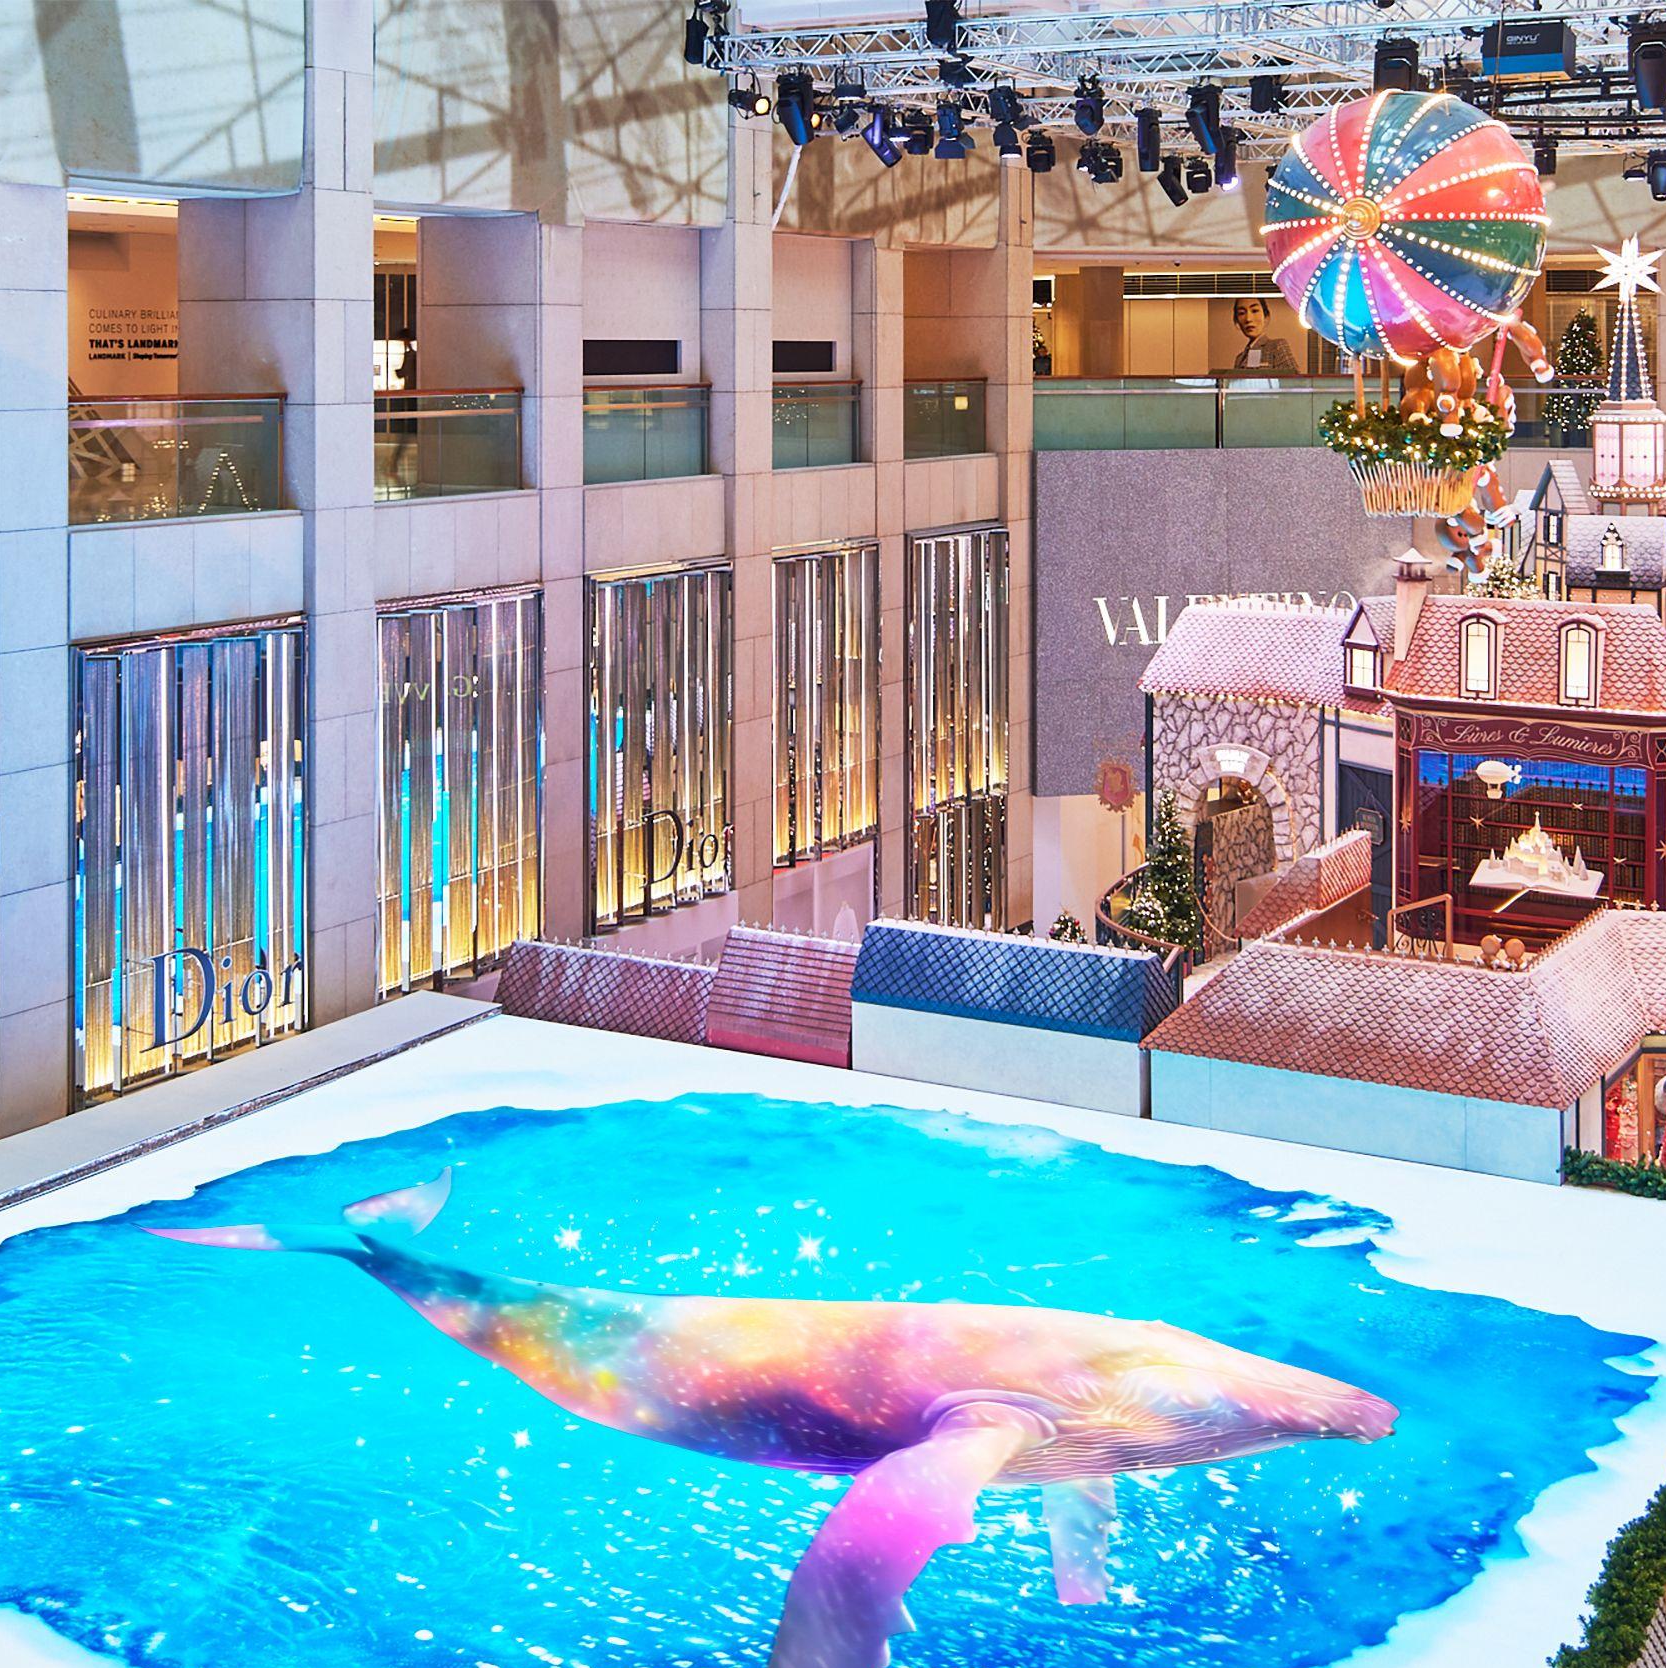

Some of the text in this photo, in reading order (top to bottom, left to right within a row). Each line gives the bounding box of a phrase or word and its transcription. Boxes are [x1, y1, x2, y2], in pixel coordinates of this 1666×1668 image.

[89, 309, 137, 319] CULINARY
[89, 323, 122, 334] COMES
[126, 323, 138, 334] TO
[141, 323, 168, 334] LIGHT
[89, 339, 124, 349] THAT'S
[1444, 725, 1503, 743] Livres
[140, 946, 303, 1053] Dior
